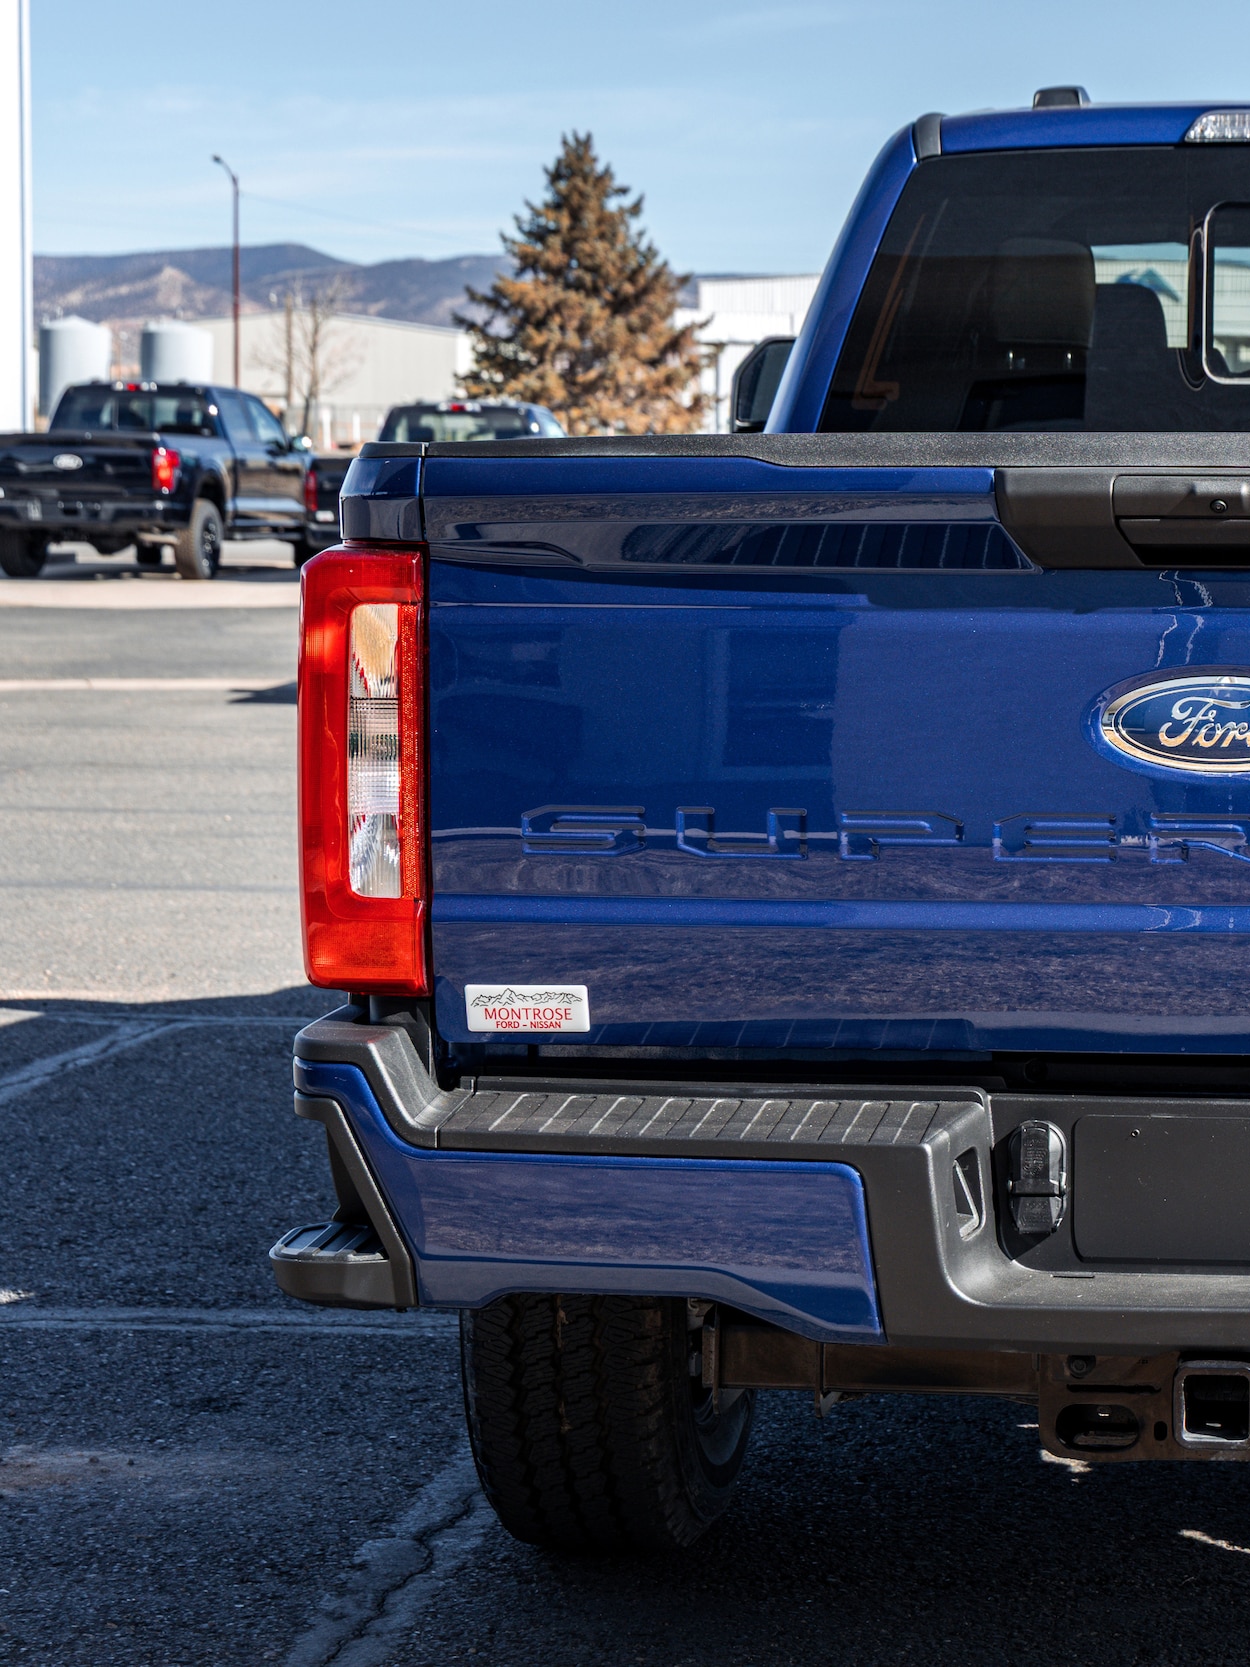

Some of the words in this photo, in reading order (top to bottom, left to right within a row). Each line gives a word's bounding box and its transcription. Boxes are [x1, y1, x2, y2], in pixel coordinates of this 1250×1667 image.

[484, 1007, 573, 1020] MONTROSE
[496, 1020, 520, 1029] FORD
[530, 1020, 562, 1029] NISSAN
